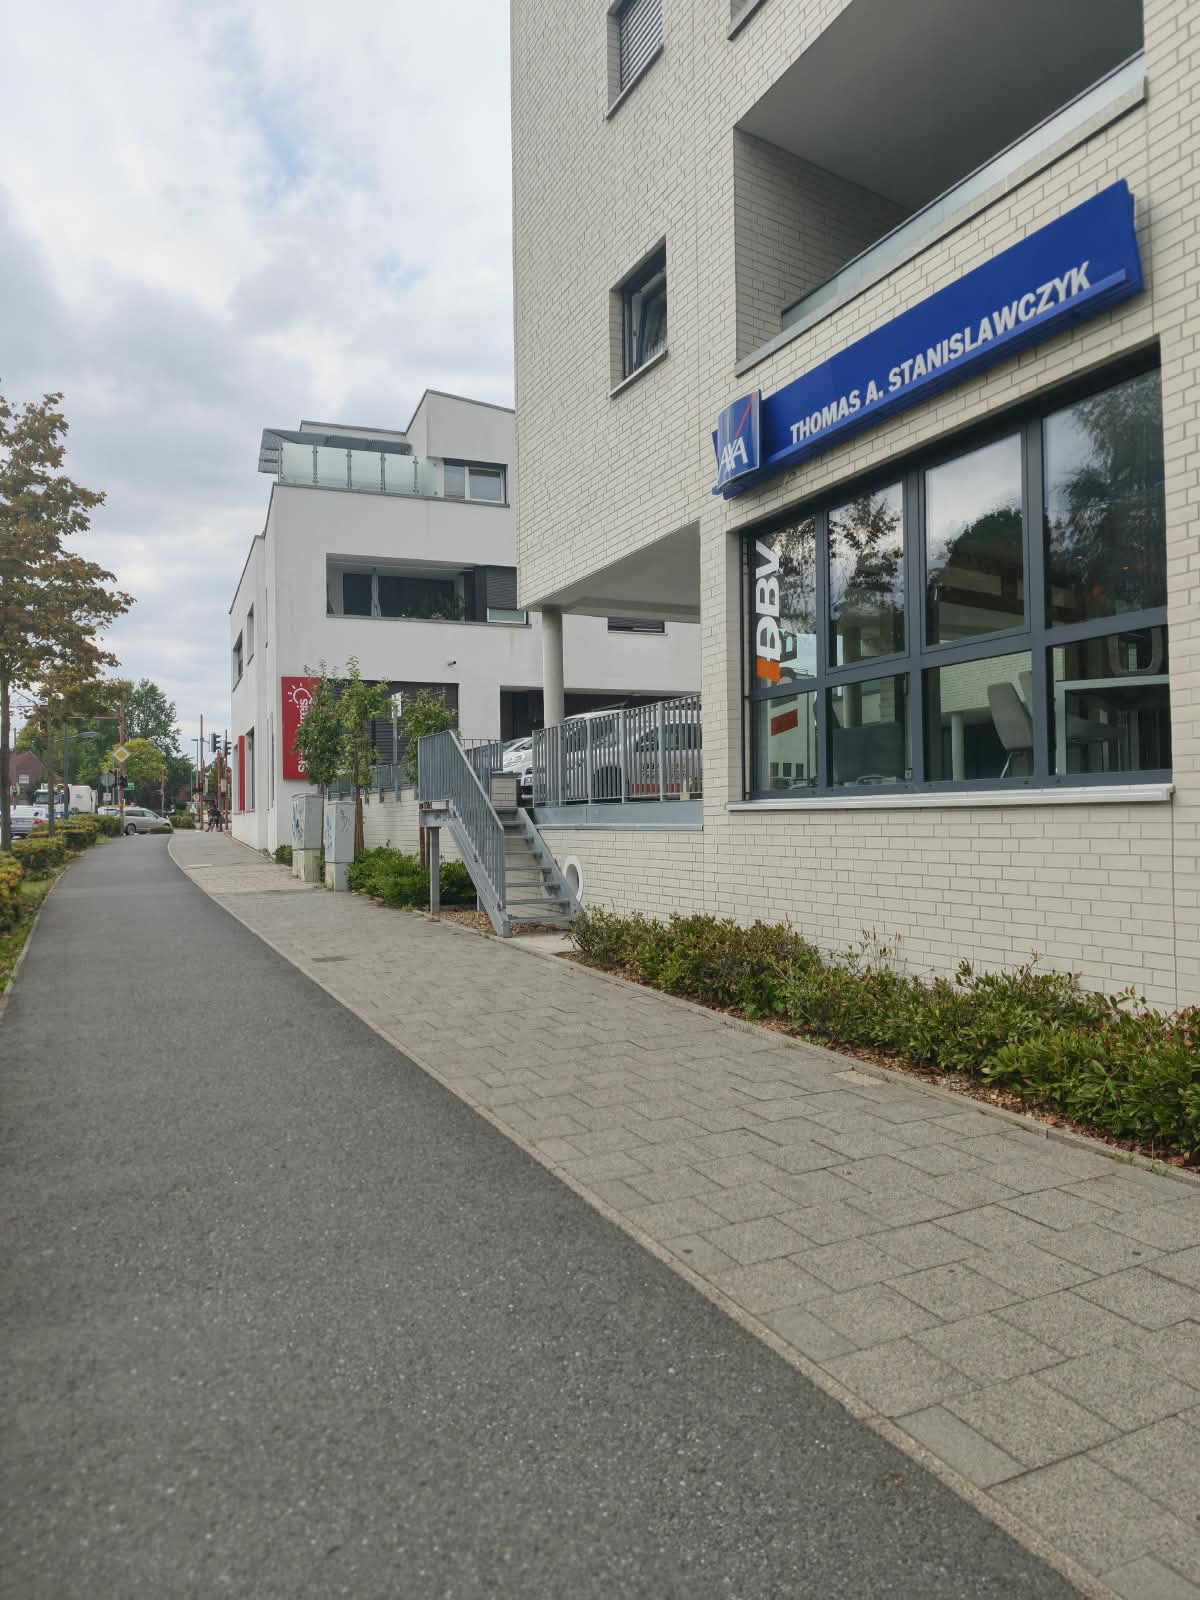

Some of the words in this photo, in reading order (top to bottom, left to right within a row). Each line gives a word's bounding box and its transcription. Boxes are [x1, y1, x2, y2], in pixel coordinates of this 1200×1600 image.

[790, 389, 862, 445] THOMAS
[865, 379, 884, 406] A.
[888, 260, 1090, 392] STANISLAWCZYK
[719, 437, 748, 474] AXA
[755, 539, 782, 661] DBV
